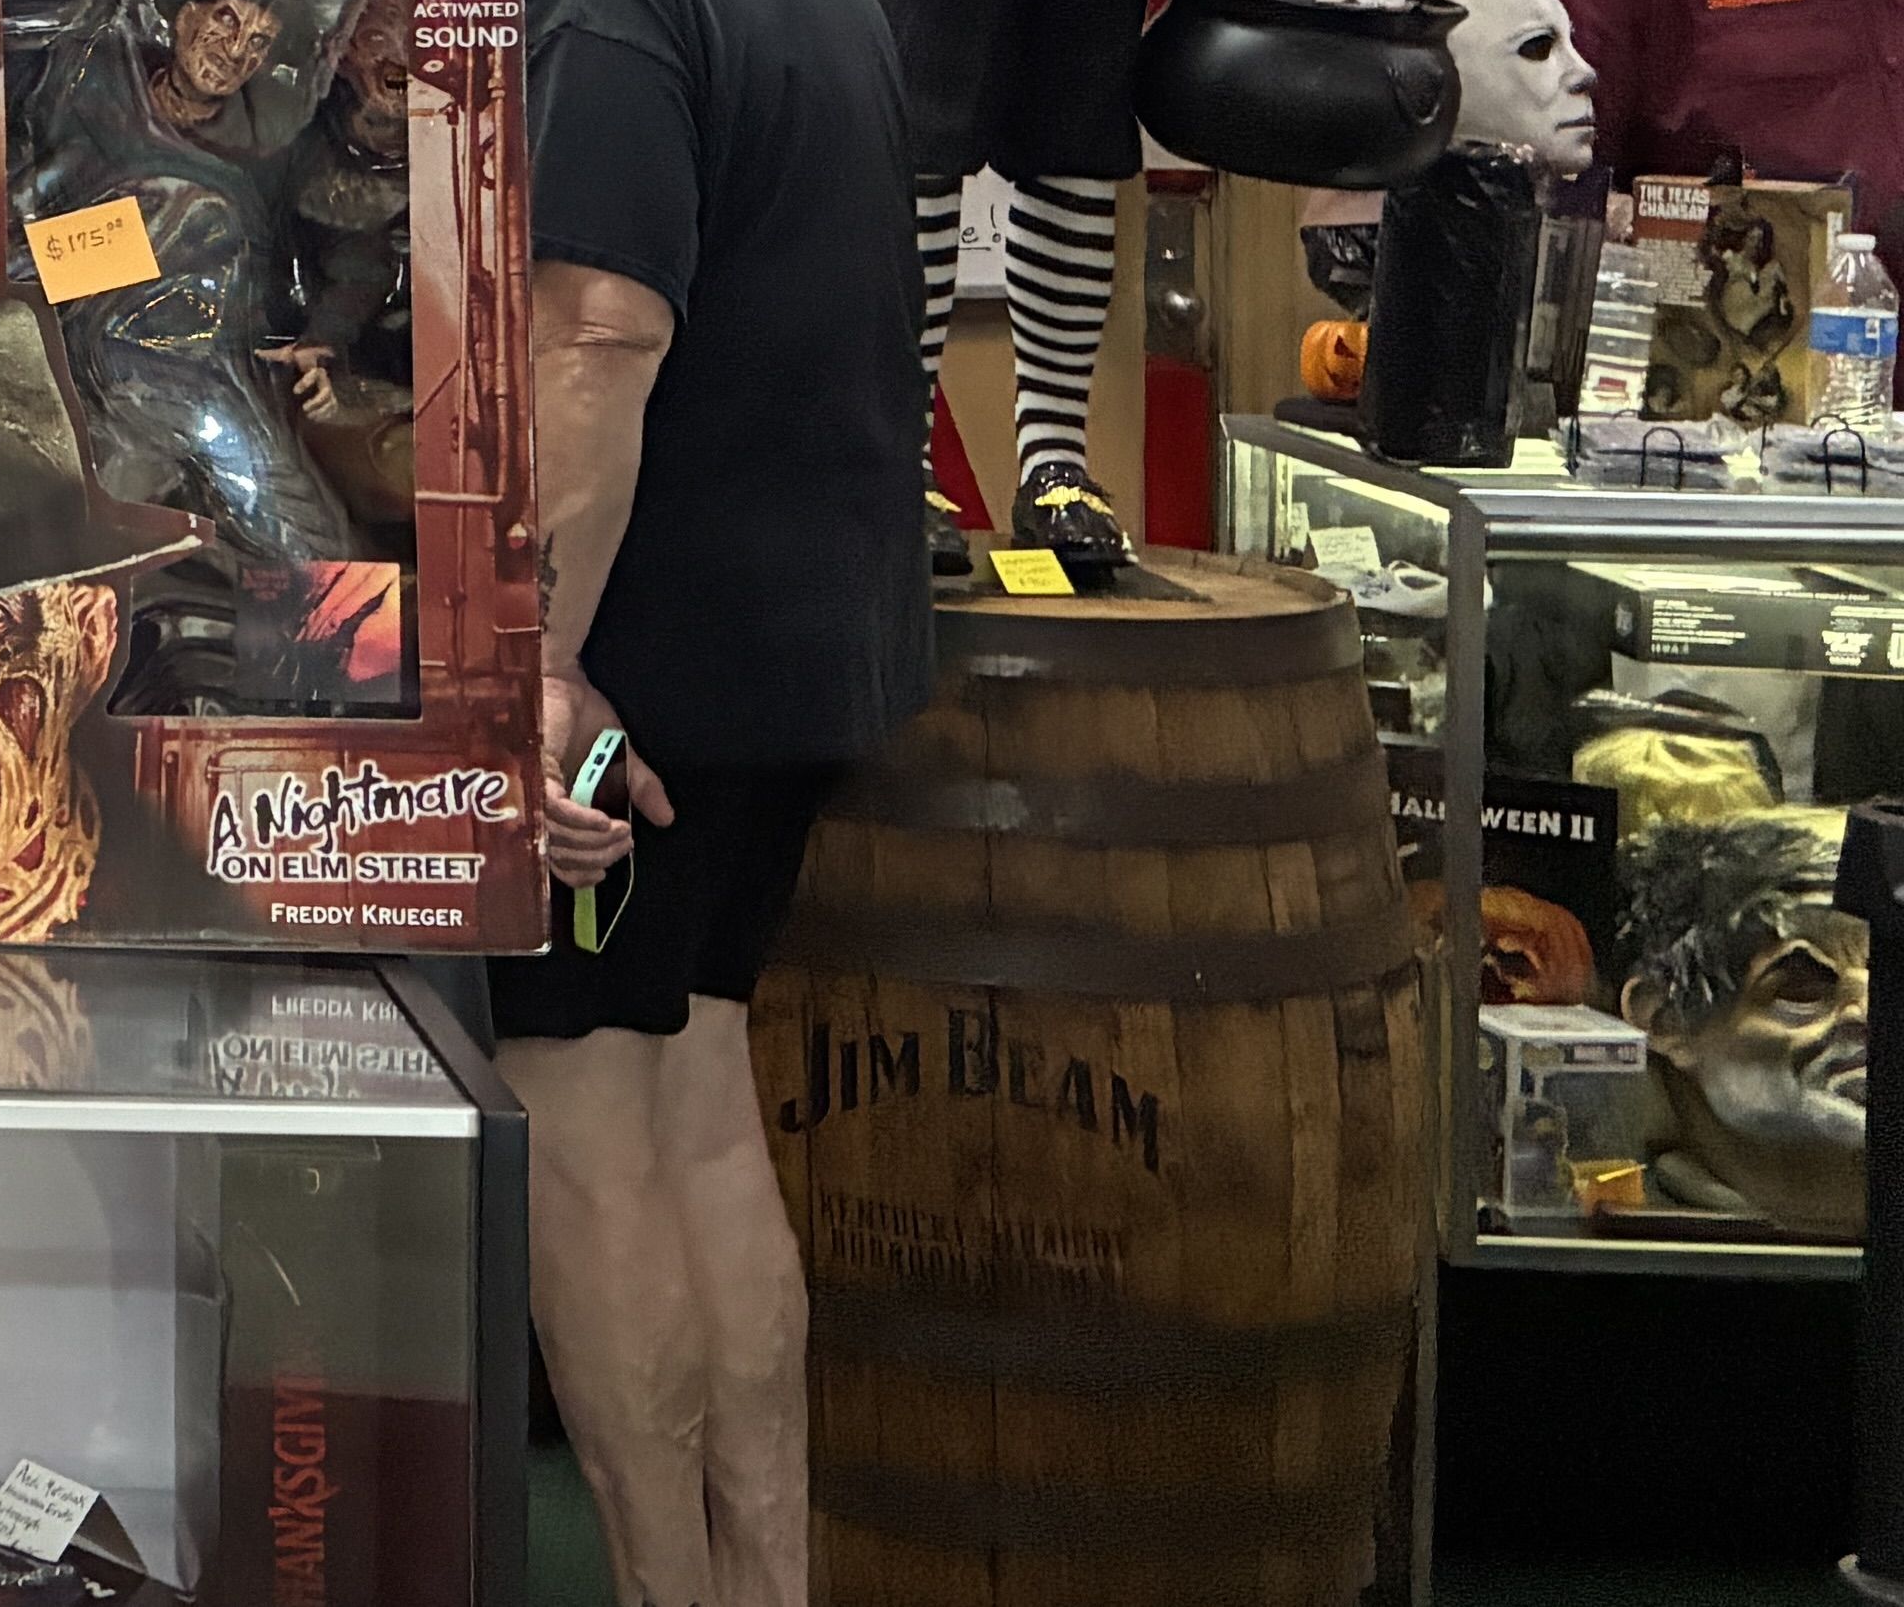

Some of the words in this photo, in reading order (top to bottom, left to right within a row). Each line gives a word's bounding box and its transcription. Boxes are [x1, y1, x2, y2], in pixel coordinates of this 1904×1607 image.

[414, 0, 520, 20] ACTIVATED
[415, 25, 519, 49] SOUND
[1640, 184, 1665, 201] THE
[1668, 187, 1710, 204] TEXAS
[208, 804, 243, 875] A
[253, 759, 518, 855] Nightmare
[221, 853, 274, 882] ON
[282, 852, 348, 882] ELM
[358, 852, 482, 882] STREET
[270, 902, 354, 926] FREDDY
[361, 903, 463, 928] KRUEGER
[780, 1022, 921, 1135] JIM
[947, 1005, 1162, 1173] BEAM
